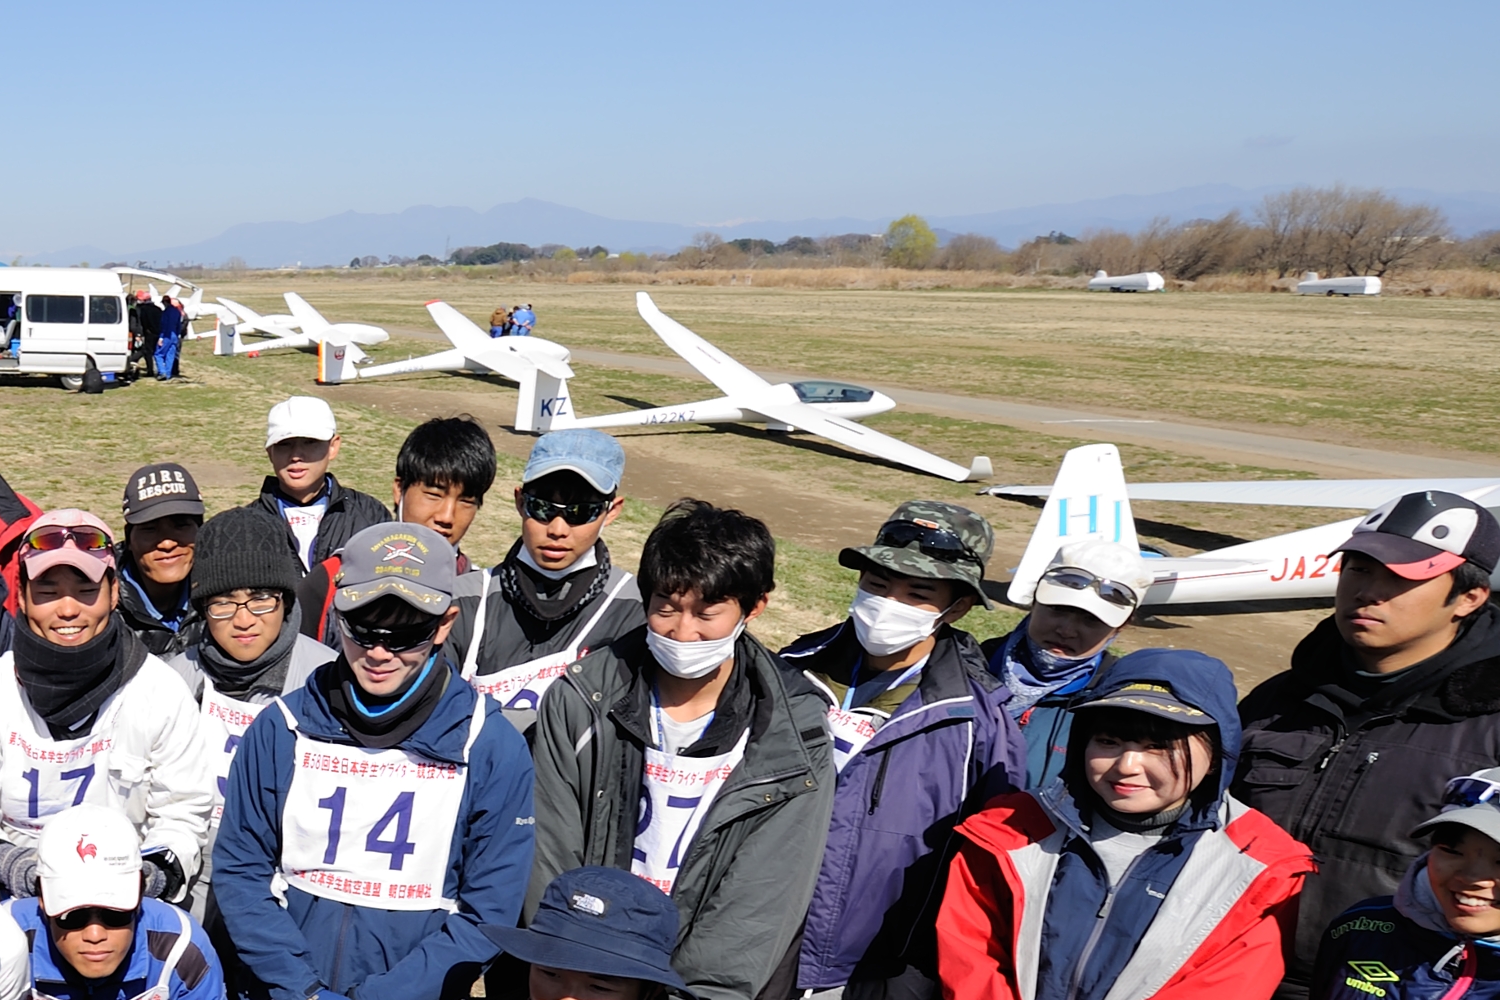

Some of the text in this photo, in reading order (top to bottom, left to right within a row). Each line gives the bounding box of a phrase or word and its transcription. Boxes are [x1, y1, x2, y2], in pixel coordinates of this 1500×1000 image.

[540, 397, 568, 418] KZ
[641, 411, 696, 426] JA22KZ
[138, 470, 185, 490] FIRE
[139, 483, 187, 501] RESCUE
[22, 763, 96, 819] 17
[318, 786, 416, 872] 14
[309, 870, 382, 898] 日本学生航空連盟
[388, 883, 432, 900] 朝日新聞社
[1330, 916, 1396, 940] umbro
[1346, 977, 1387, 998] umbro
